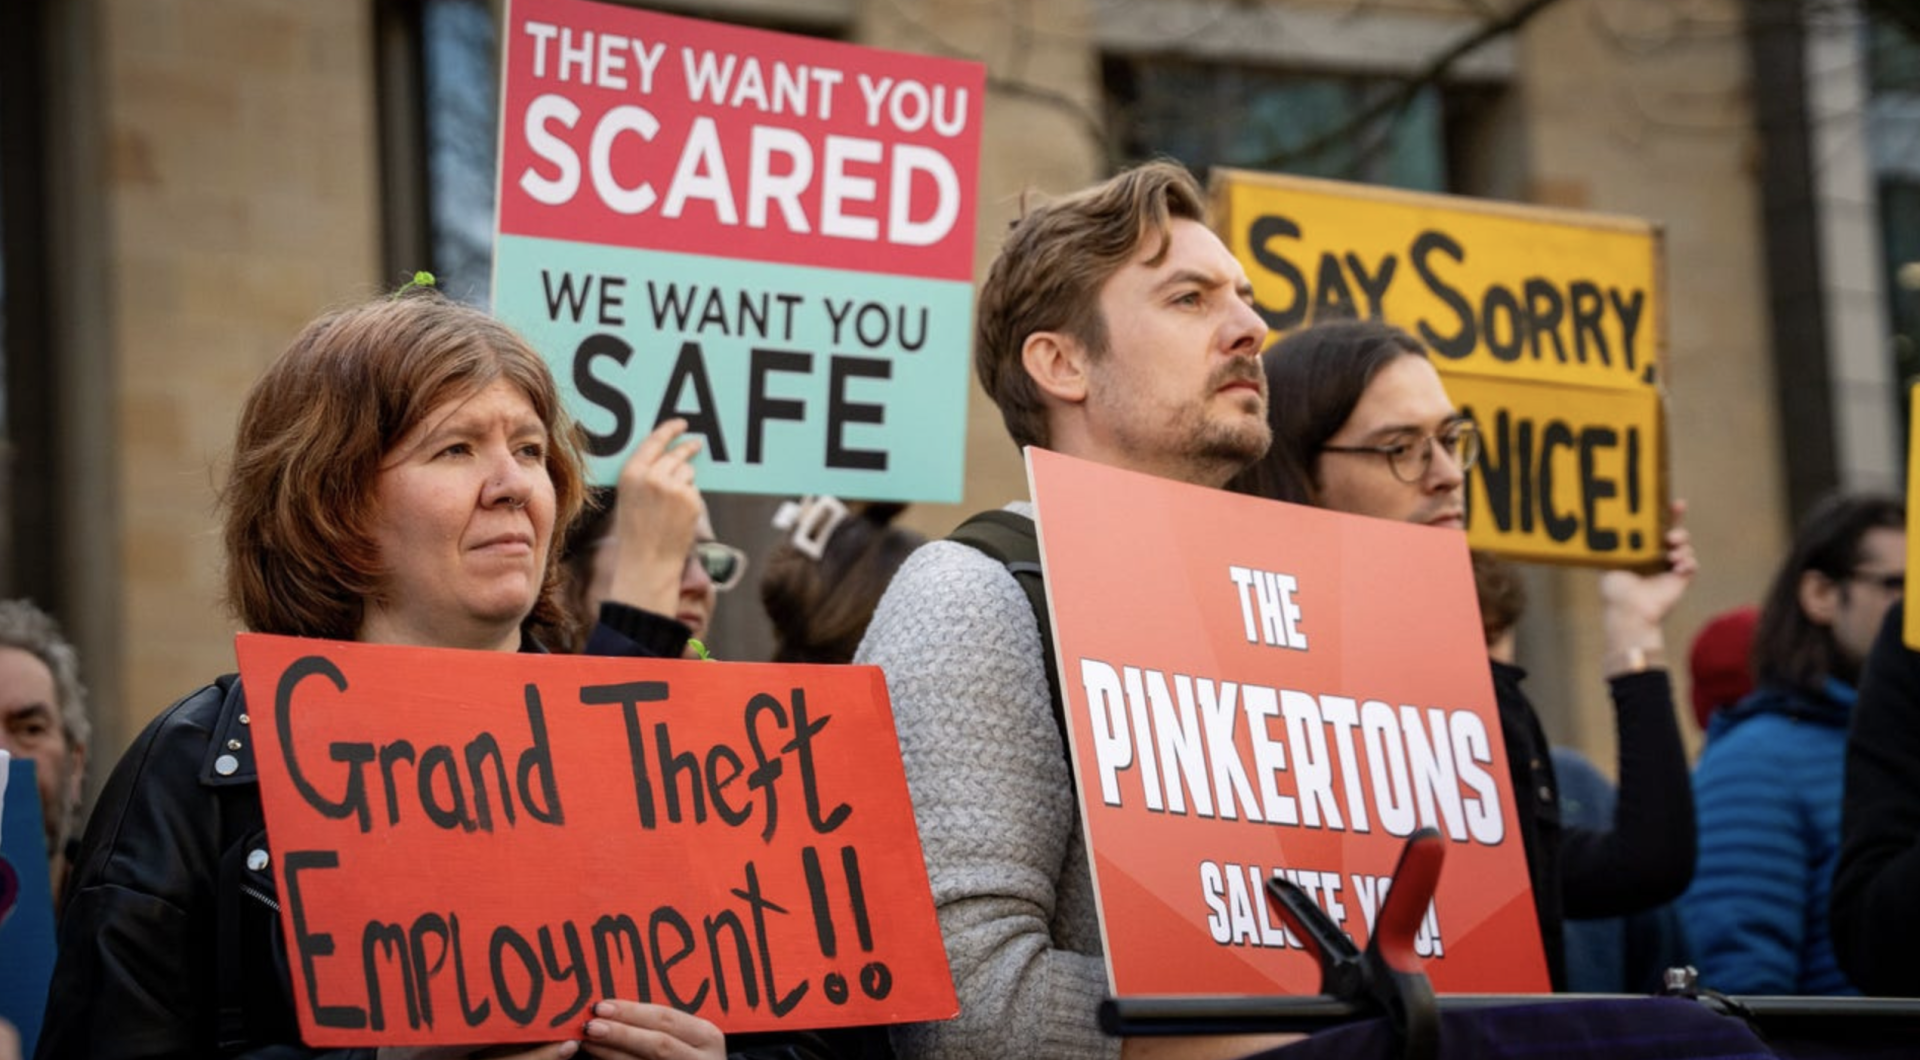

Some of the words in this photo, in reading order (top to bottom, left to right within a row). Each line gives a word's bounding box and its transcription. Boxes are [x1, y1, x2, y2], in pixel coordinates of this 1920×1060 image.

[524, 21, 666, 94] THEY
[682, 47, 843, 120] WANT
[858, 74, 968, 137] YOU
[518, 94, 961, 247] SCARED
[541, 269, 626, 327] WE
[647, 280, 805, 341] WANT
[823, 298, 929, 352] YOU
[1248, 213, 1398, 331] SAY
[1410, 229, 1657, 385] SORRY,
[572, 333, 893, 472] SAFE
[1460, 406, 1643, 552] NICE!
[1229, 565, 1308, 651] THE
[274, 655, 564, 834] Grand
[579, 680, 853, 843] Theft
[1079, 657, 1505, 846] PINKERTONS
[1350, 874, 1445, 958] Y!
